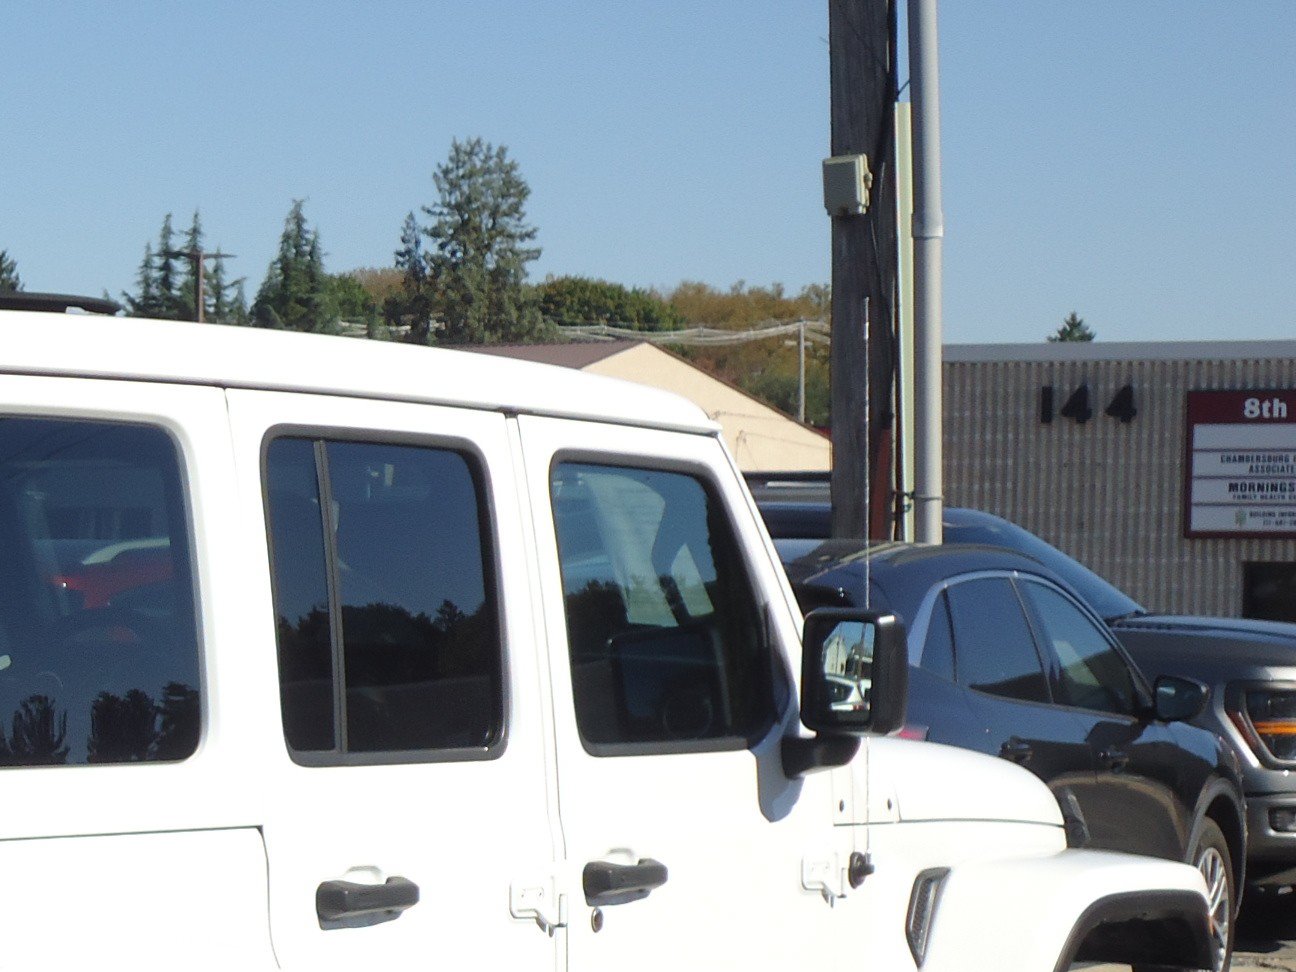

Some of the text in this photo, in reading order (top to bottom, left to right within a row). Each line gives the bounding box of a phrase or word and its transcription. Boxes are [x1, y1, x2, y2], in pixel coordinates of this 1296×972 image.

[1041, 385, 1137, 423] 144
[1243, 397, 1288, 419] 8th
[1220, 454, 1290, 463] CHAMBERSBURG
[1228, 482, 1296, 492] MORNINGS
